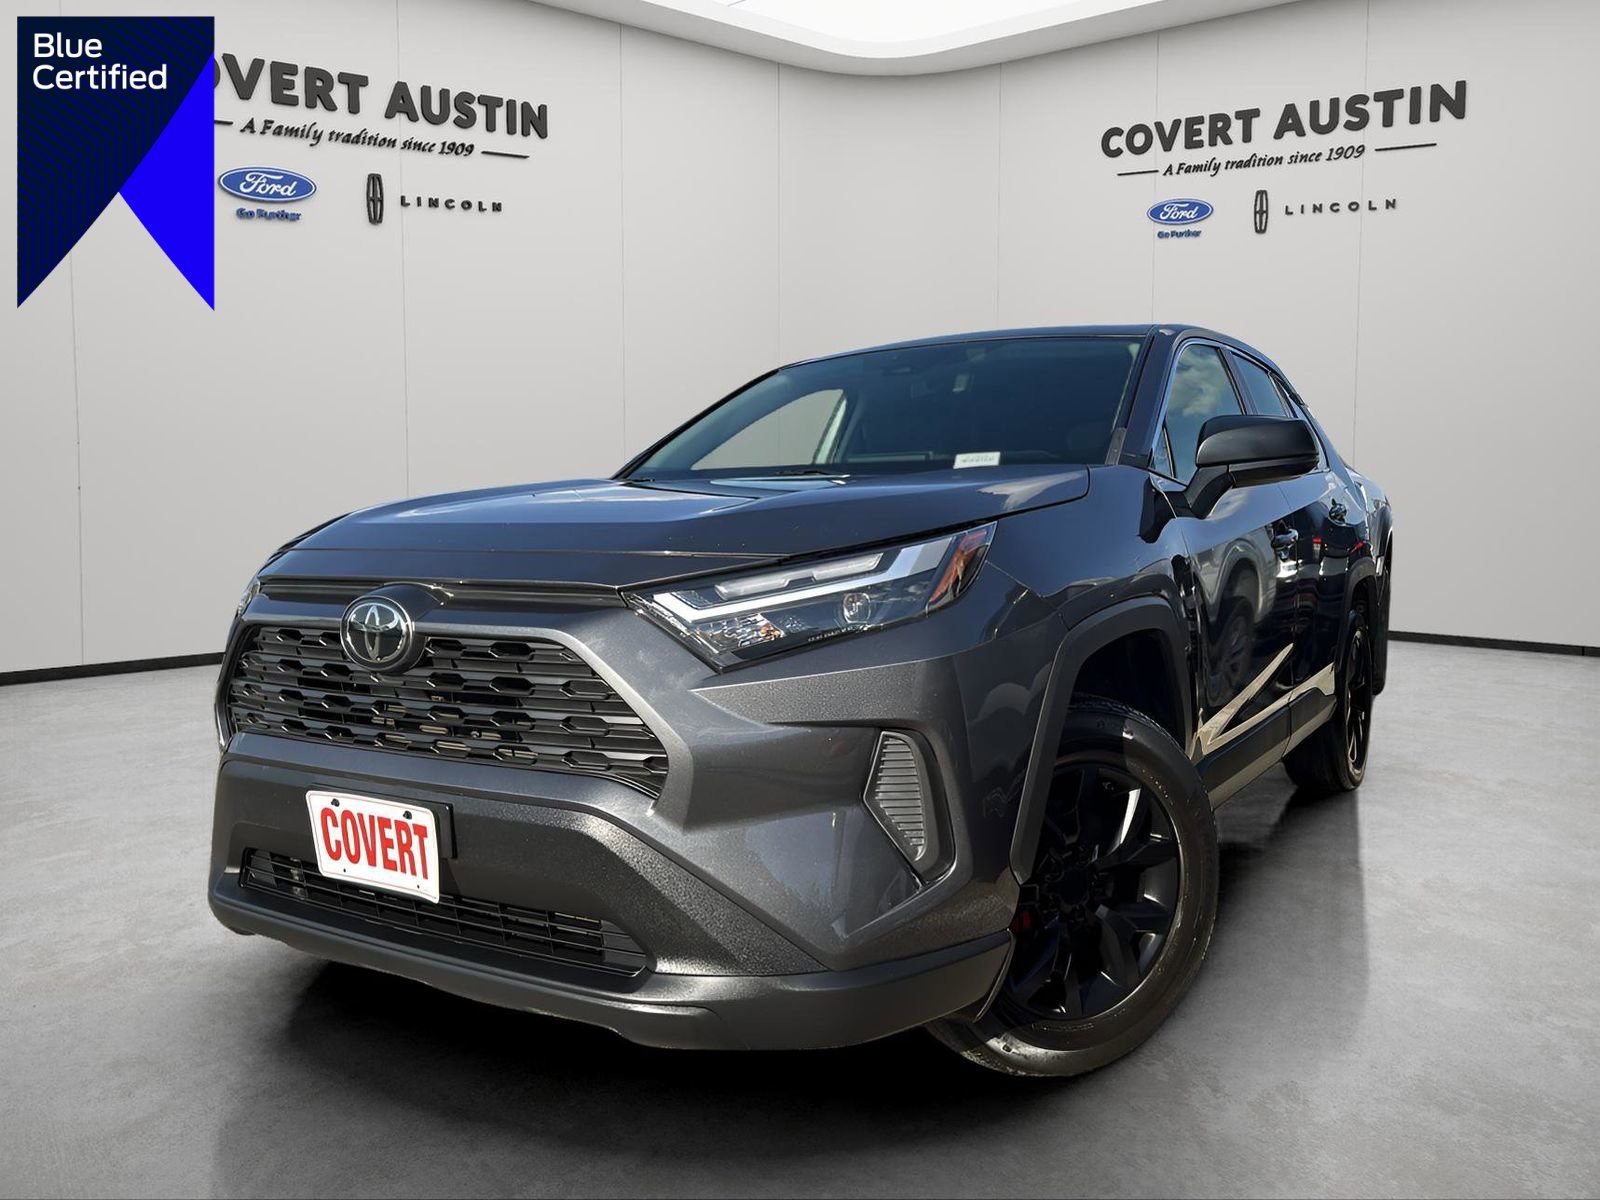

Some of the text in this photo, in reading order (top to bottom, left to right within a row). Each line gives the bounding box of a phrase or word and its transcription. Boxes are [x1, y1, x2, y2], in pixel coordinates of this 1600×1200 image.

[384, 81, 548, 139] AUSTIN
[1100, 80, 1467, 158] COVERT AUSTIN
[240, 118, 475, 157] A Family tradition since 1909
[1162, 144, 1366, 177] A Family tradition since 1909
[240, 172, 298, 197] Ford
[400, 195, 502, 213] LINCOLN
[1160, 203, 1199, 220] Ford
[1284, 198, 1397, 216] LINCOLN
[320, 807, 428, 880] COVERT
